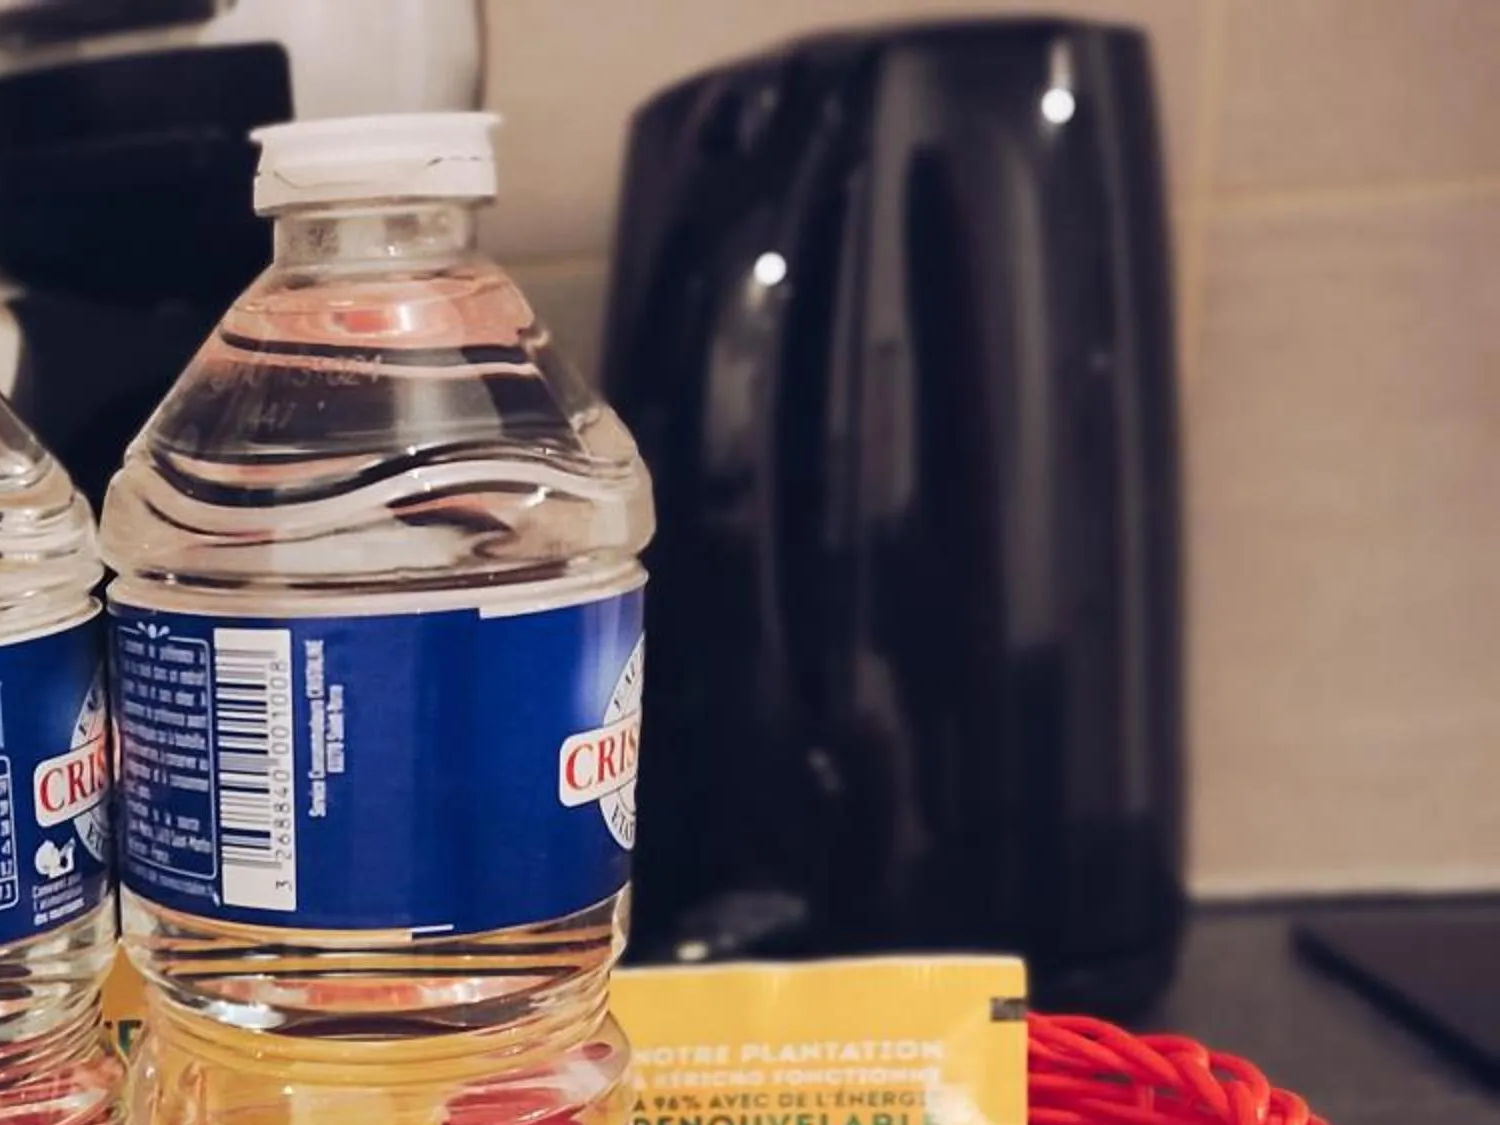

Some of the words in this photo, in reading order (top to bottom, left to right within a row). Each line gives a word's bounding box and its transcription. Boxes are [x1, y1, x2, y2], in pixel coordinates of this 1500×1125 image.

[740, 1038, 945, 1063] PLANTATION
[708, 1092, 770, 1111] AVEC
[777, 1091, 805, 1109] DE
[814, 1087, 938, 1109] L'ÉNERGI
